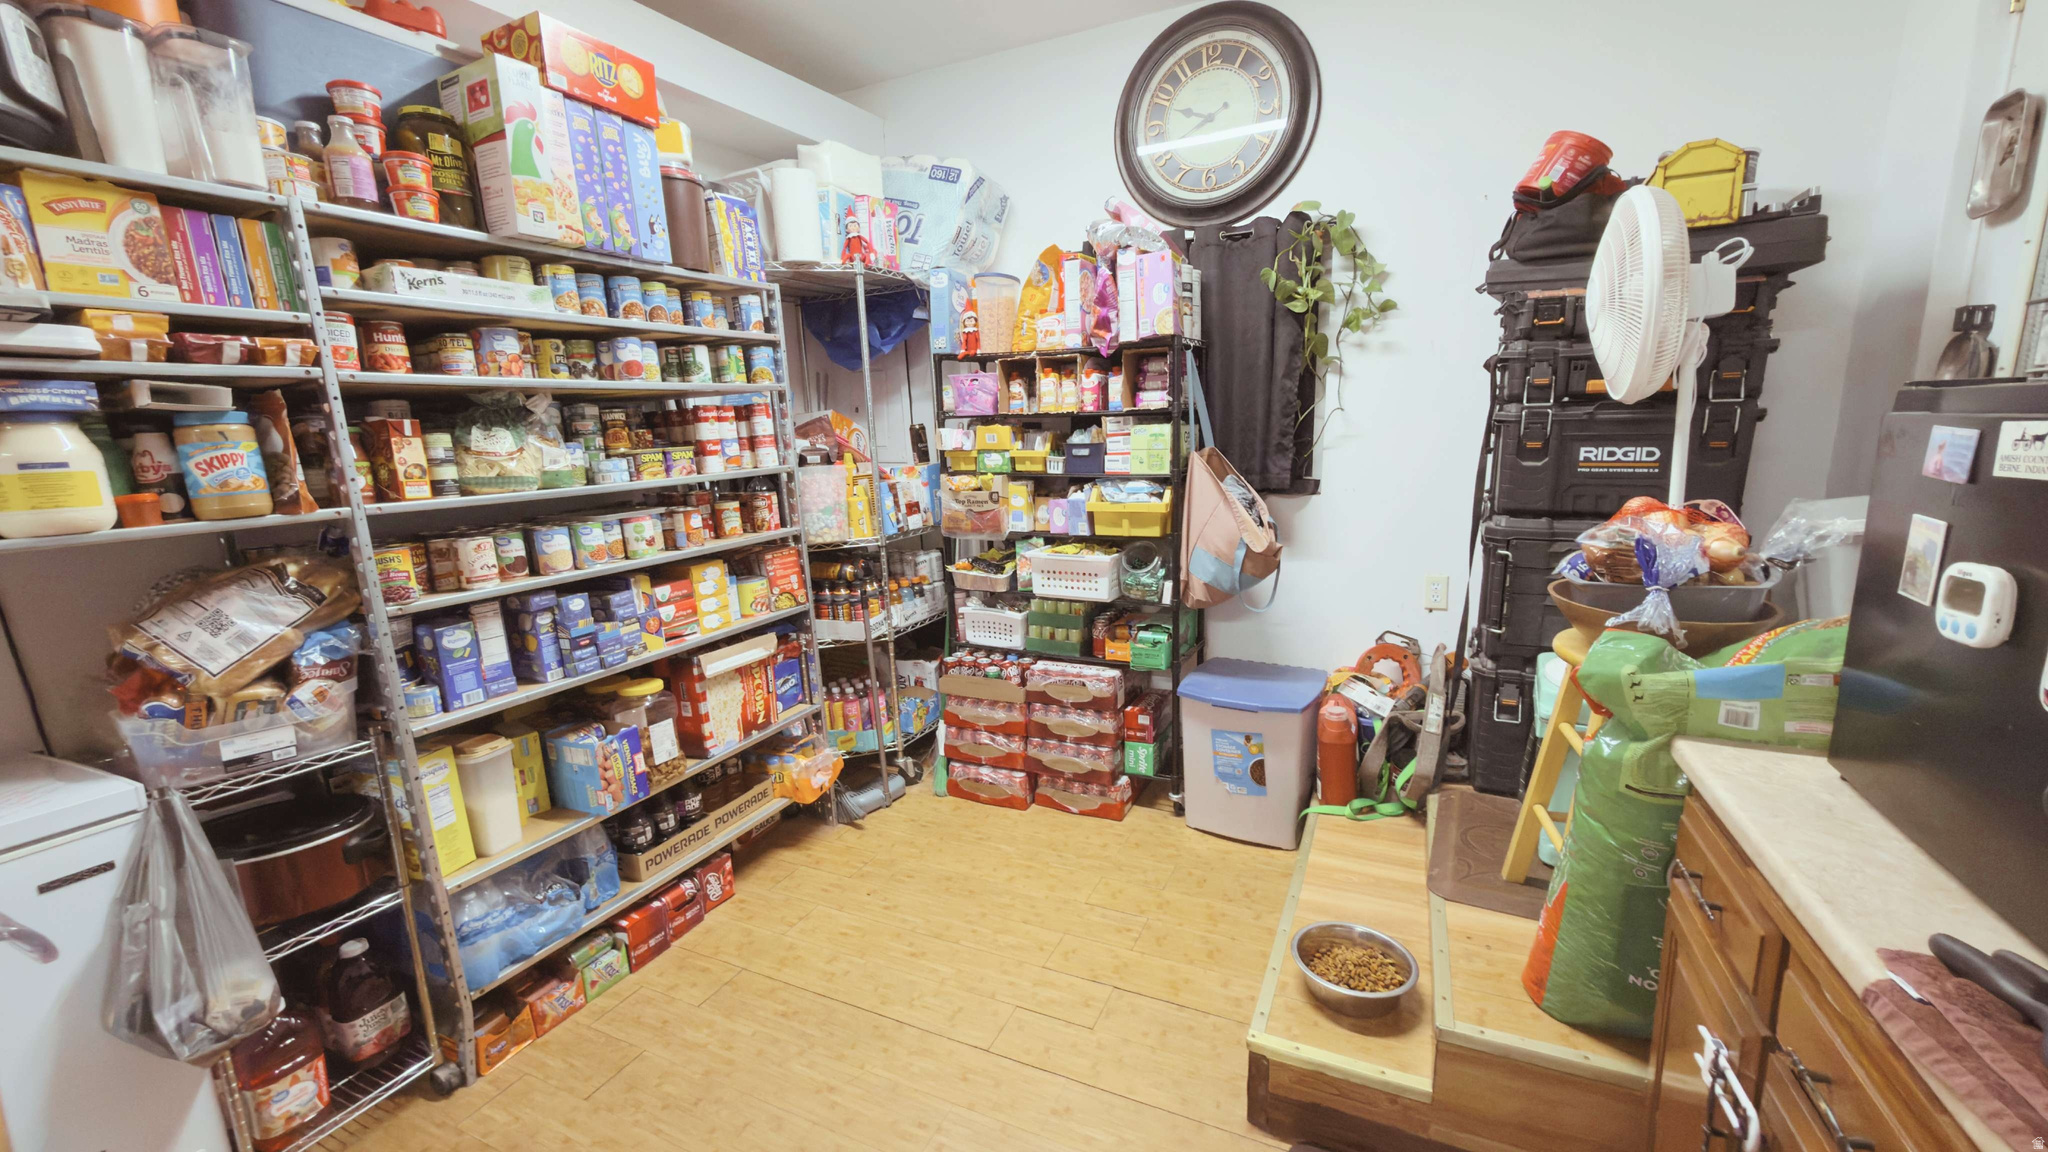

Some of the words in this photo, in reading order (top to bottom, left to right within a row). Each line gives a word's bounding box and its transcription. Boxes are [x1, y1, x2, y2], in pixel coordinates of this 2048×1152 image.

[1201, 44, 1223, 69] 12
[1233, 46, 1249, 69] 1
[589, 50, 618, 81] RITZ
[1172, 59, 1193, 81] 11
[1250, 66, 1272, 89] 2
[1153, 83, 1176, 107] 10
[1258, 98, 1279, 115] 3
[1147, 120, 1166, 137] 9
[1173, 164, 1193, 186] 7
[1230, 156, 1246, 177] 5
[930, 168, 947, 181] 160
[948, 171, 960, 183] 12
[1201, 168, 1217, 189] 6
[51, 199, 78, 212] TASTY
[79, 198, 104, 211] BITE
[65, 234, 109, 249] Madras
[72, 244, 111, 257] Lentils
[138, 285, 149, 298] 6
[407, 276, 445, 291] Kern's
[450, 338, 467, 348] TEL
[9, 394, 83, 407] BROWNIES
[640, 452, 663, 463] SPAM
[672, 450, 694, 460] SPAM
[1578, 446, 1661, 462] RIDGID
[2000, 454, 2021, 463] AMISH
[2023, 455, 2048, 465] COUNT
[194, 452, 245, 478] SKIPPY
[2024, 465, 2048, 475] INDIA
[954, 498, 968, 507] Top
[968, 498, 989, 506] Ramen
[622, 738, 632, 766] VIENNA
[628, 764, 639, 796] SAUSAGE
[1136, 747, 1148, 774] Sprite
[645, 825, 711, 872] POWERADE
[715, 788, 770, 829] POWERADE
[754, 815, 777, 834] SAUCE
